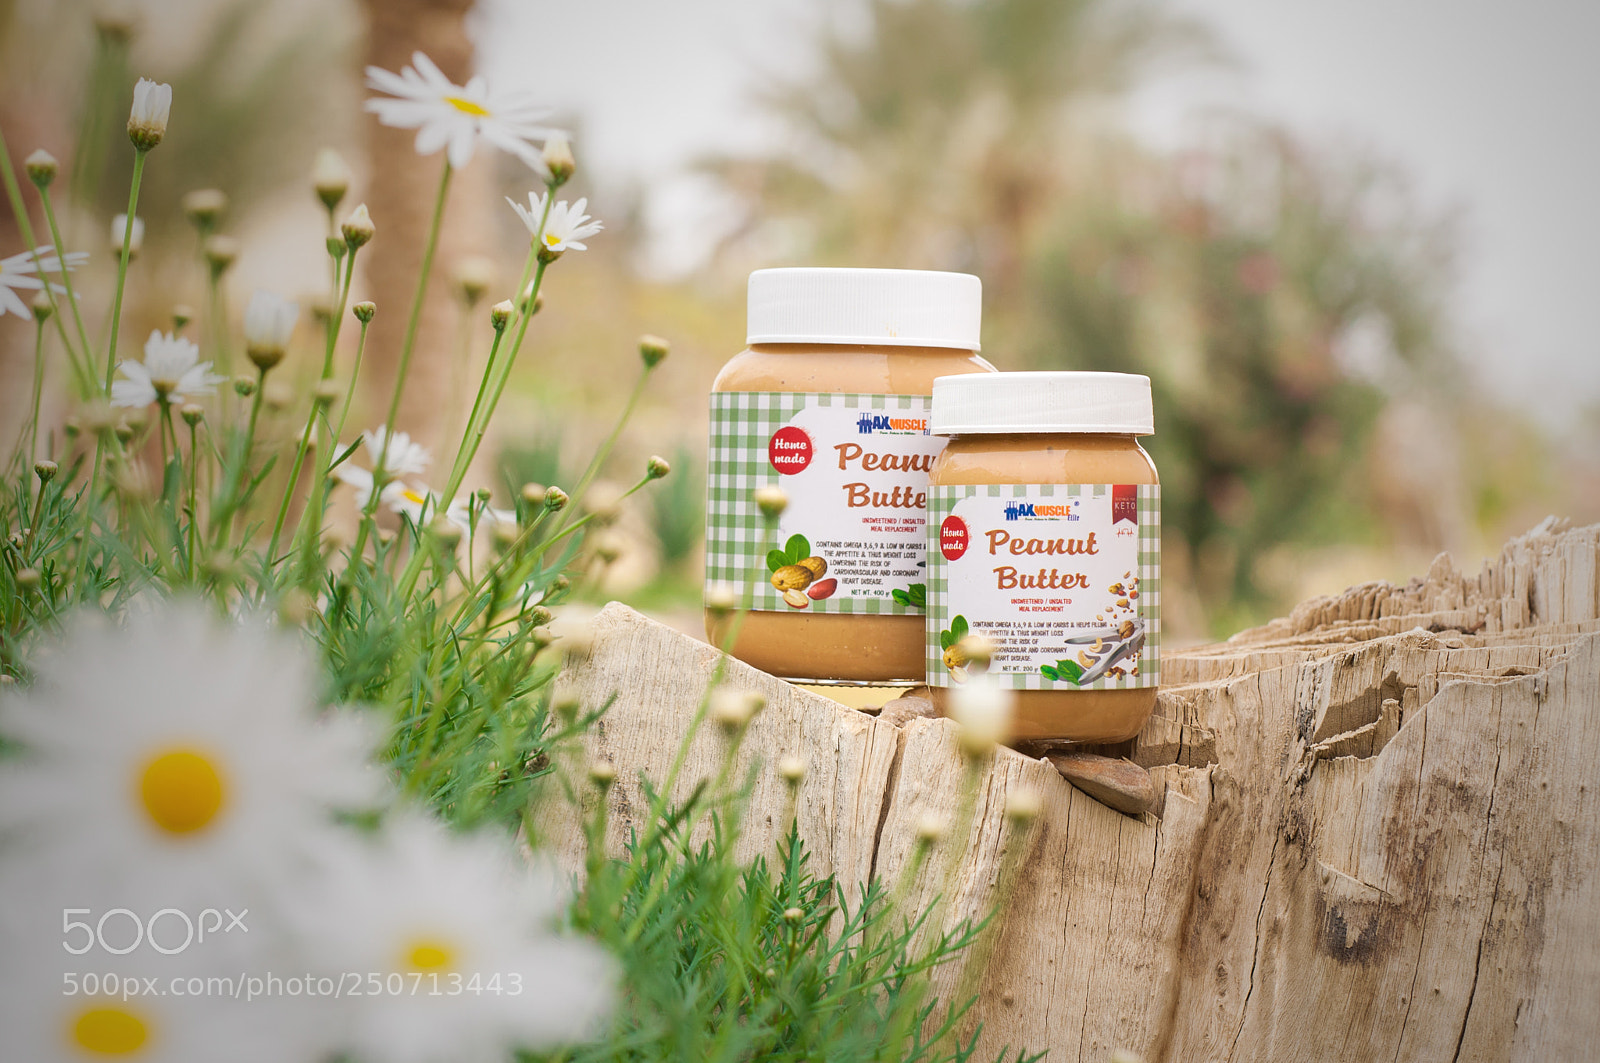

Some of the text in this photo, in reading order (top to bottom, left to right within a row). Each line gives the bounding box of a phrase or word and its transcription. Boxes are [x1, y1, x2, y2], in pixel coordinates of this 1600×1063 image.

[774, 438, 807, 450] Home
[774, 453, 806, 464] made
[842, 482, 926, 509] Butte
[943, 527, 964, 537] Home
[943, 540, 963, 550] made
[984, 529, 1099, 556] Peanut
[993, 566, 1090, 589] Butter
